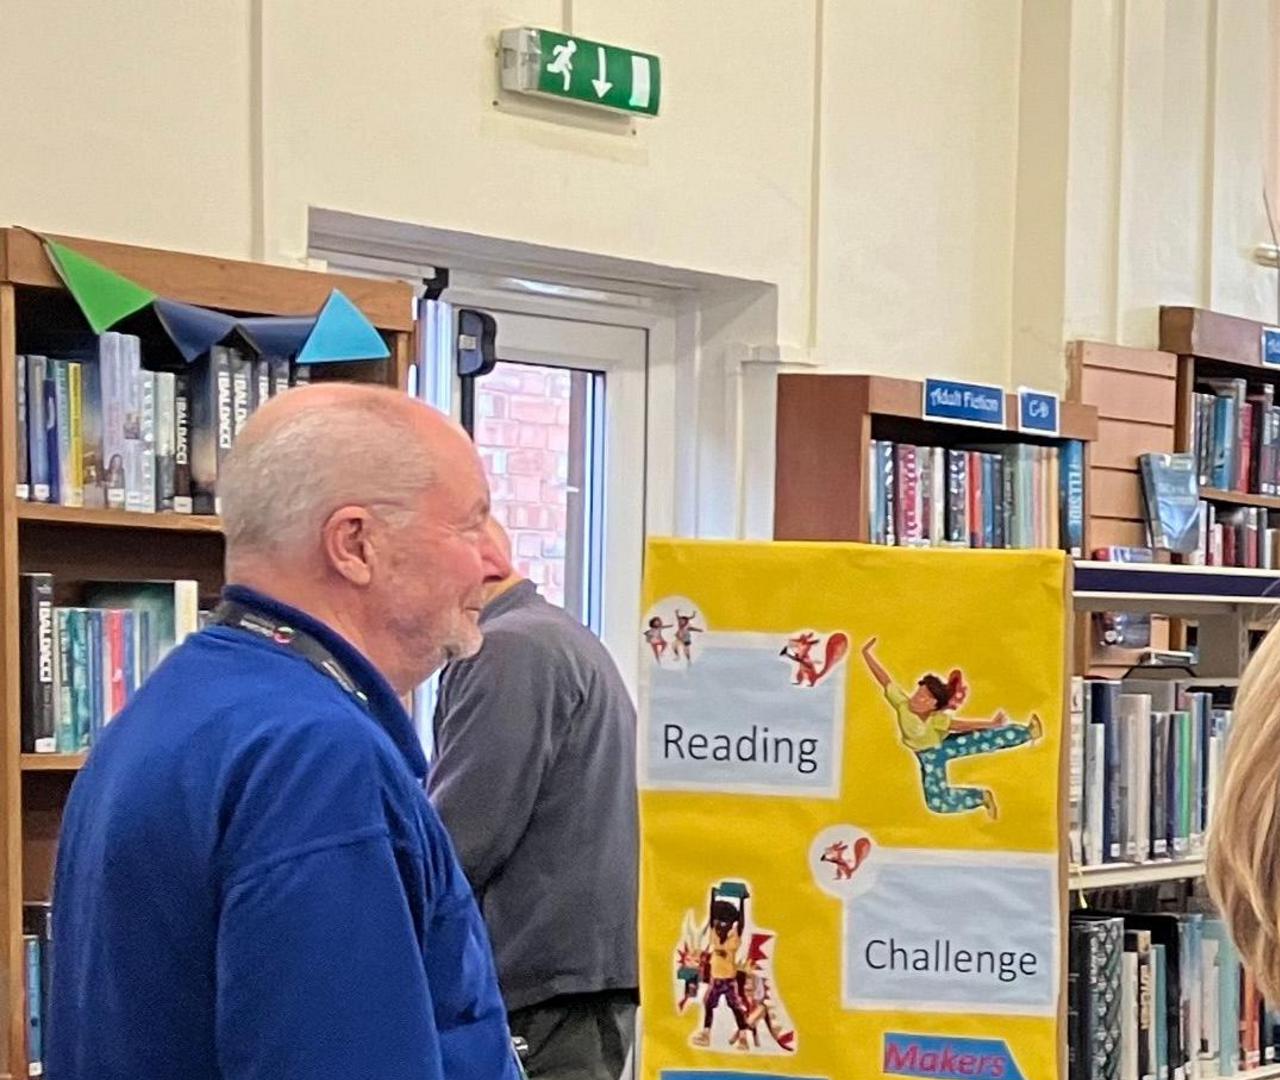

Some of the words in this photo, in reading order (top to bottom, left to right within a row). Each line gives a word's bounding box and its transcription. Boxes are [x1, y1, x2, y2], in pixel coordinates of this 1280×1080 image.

[218, 379, 231, 448] BALDACCI
[930, 388, 961, 407] Adult
[963, 391, 999, 412] Fiction
[176, 402, 187, 464] BALDACCI
[39, 608, 52, 682] BALDACCI
[664, 724, 818, 774] Reading
[865, 938, 1037, 982] Challenge
[884, 1041, 1006, 1078] Makers
